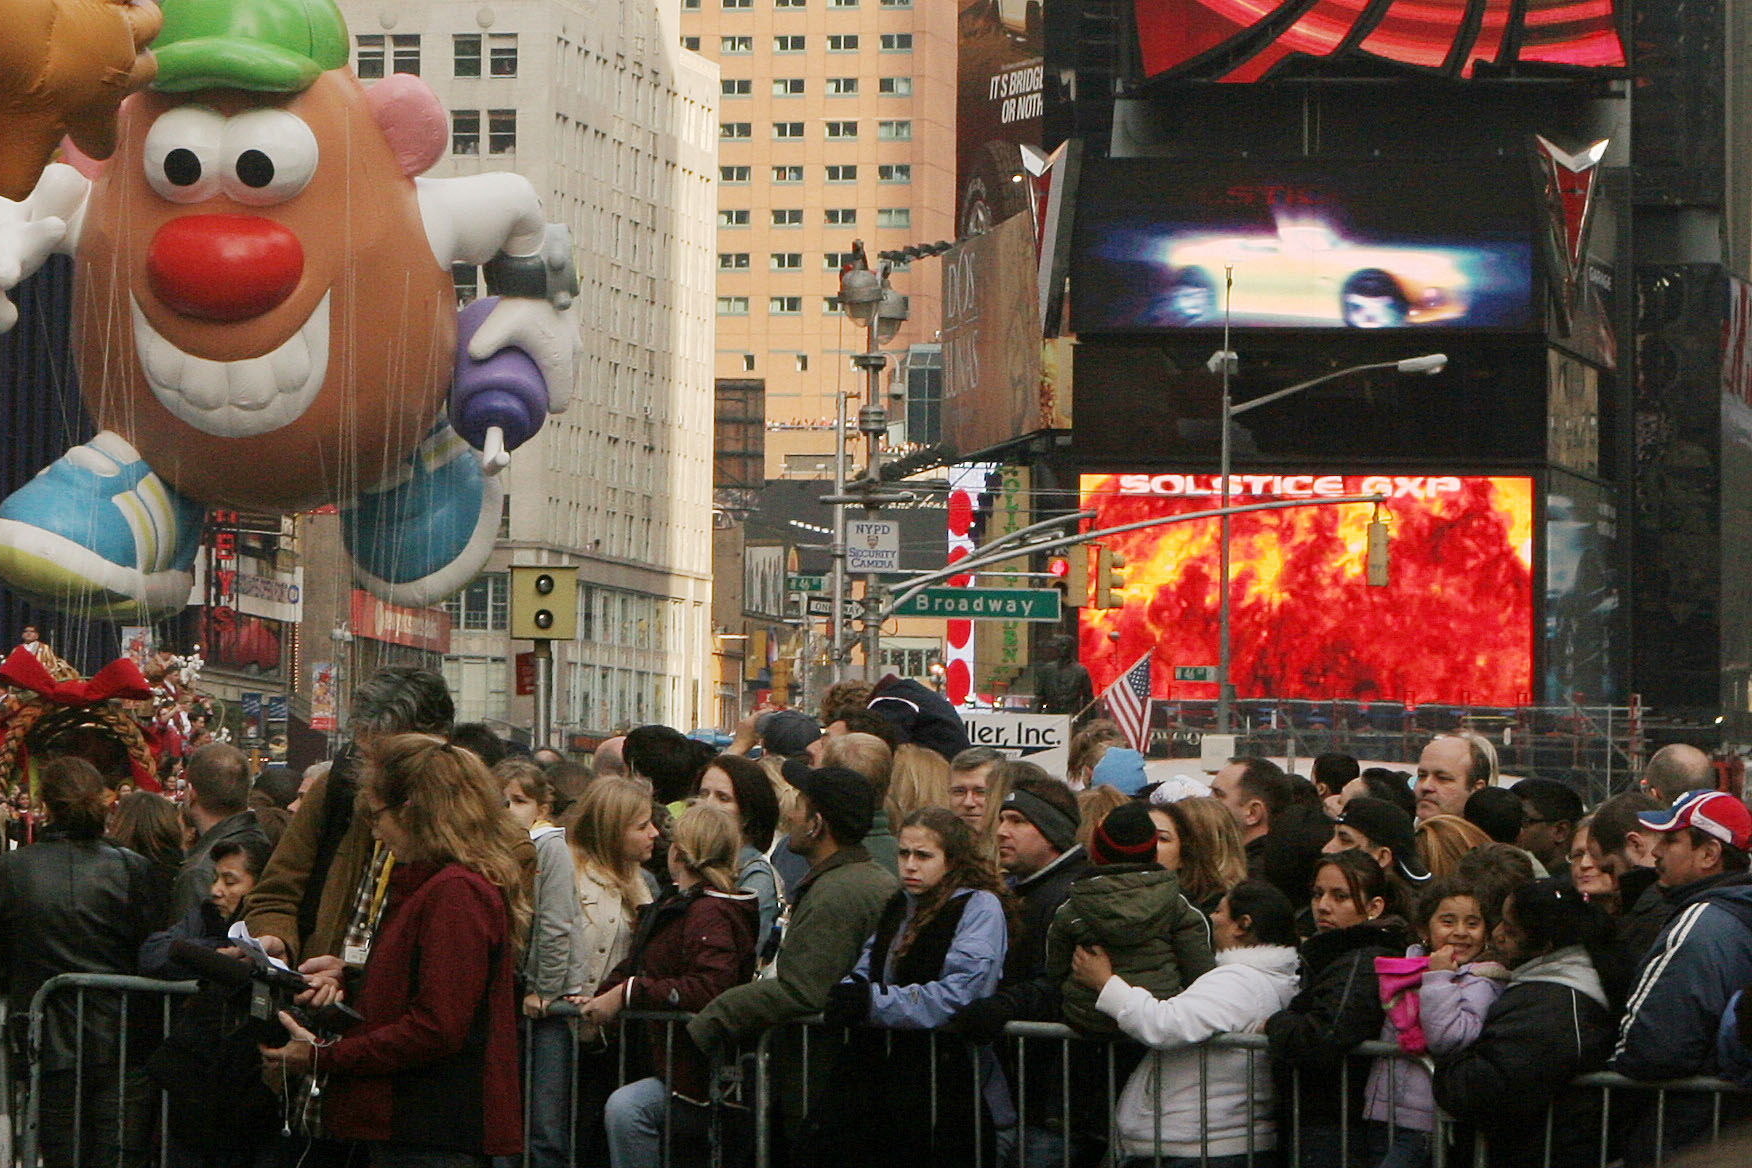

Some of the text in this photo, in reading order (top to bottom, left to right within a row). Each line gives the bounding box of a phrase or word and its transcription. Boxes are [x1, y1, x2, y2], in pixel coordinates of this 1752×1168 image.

[1002, 98, 1016, 123] OR
[1120, 474, 1461, 499] SOLSTICE GXP
[855, 524, 890, 535] NYPD
[848, 547, 896, 559] SECURITY
[851, 558, 893, 569] CAMERA
[916, 594, 1034, 615] Broadway
[1017, 721, 1062, 746] Inc.
